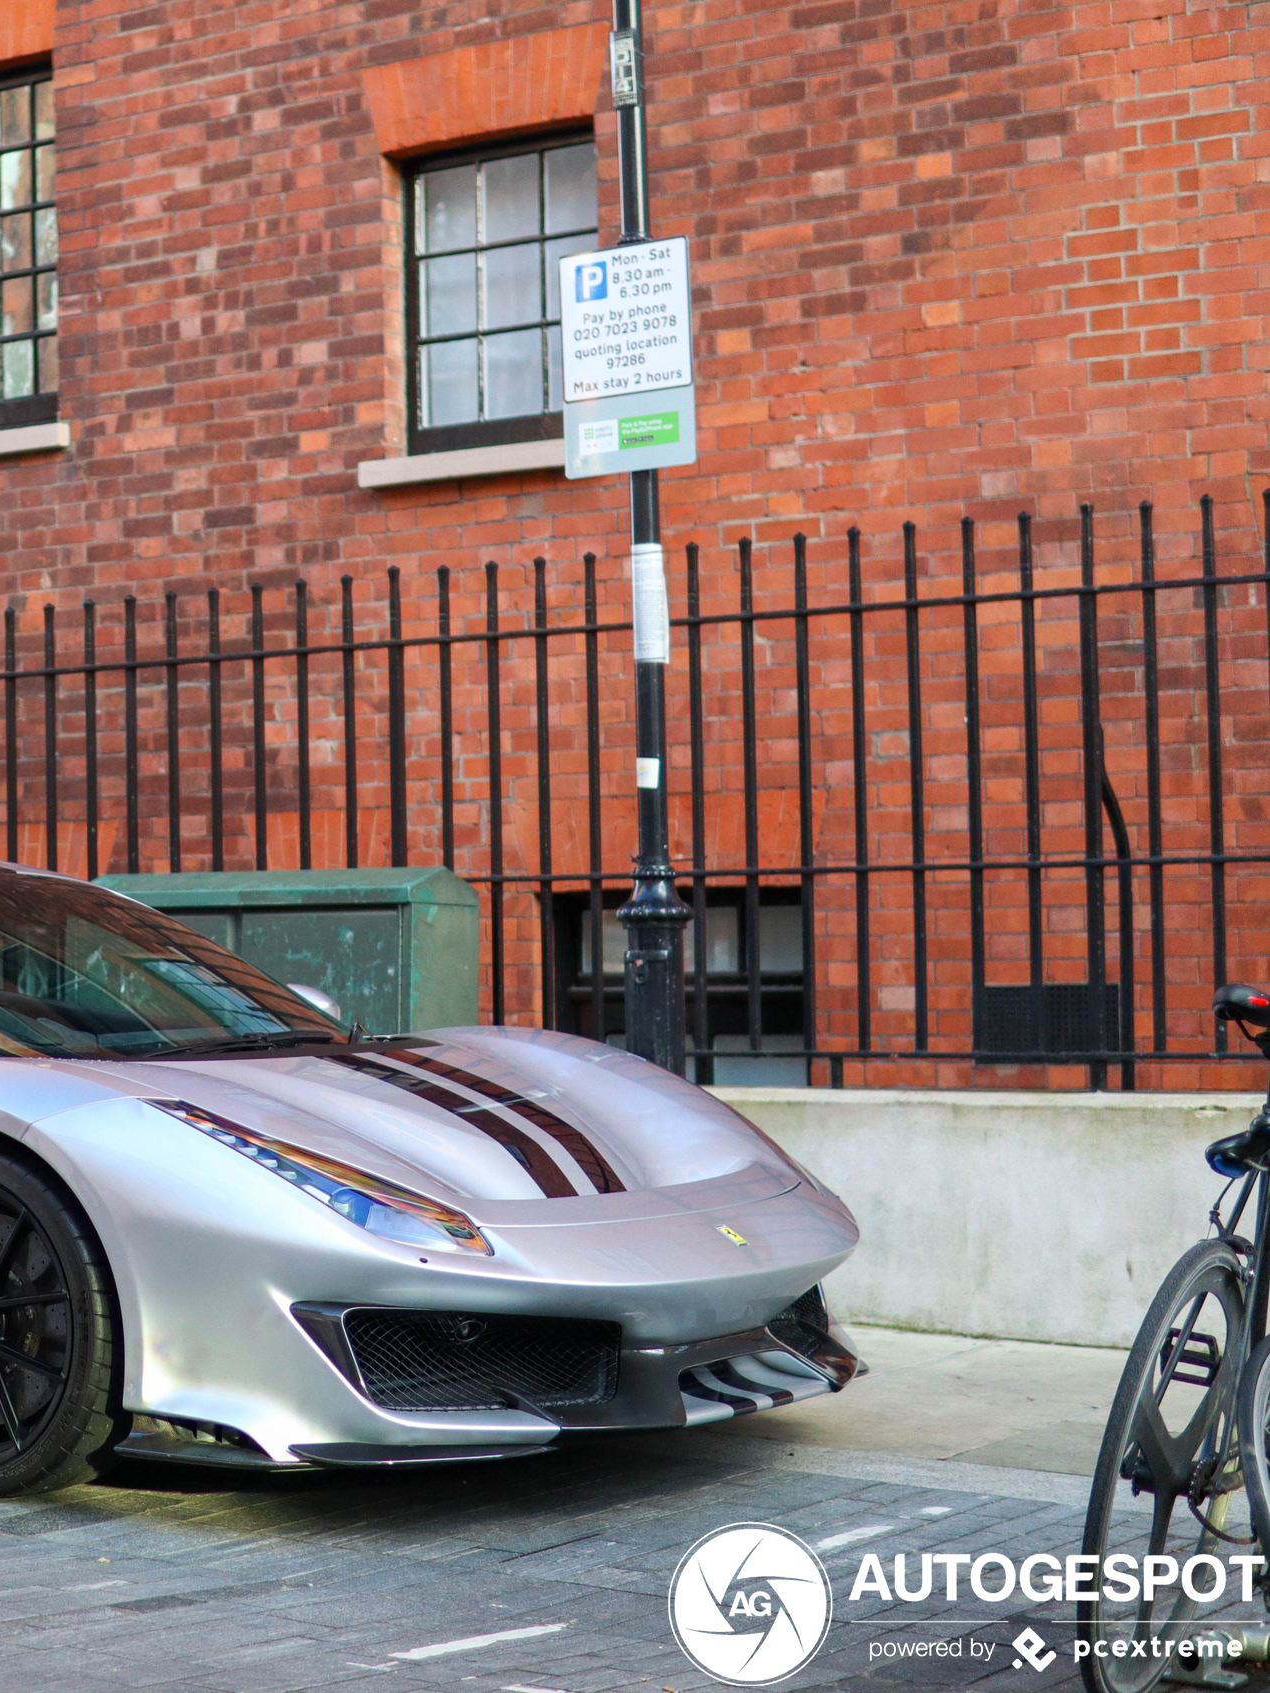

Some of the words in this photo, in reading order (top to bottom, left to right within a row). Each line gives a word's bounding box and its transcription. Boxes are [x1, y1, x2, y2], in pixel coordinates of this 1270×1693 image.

[612, 254, 638, 267] Mon
[649, 247, 671, 261] Sat
[582, 266, 603, 299] P
[613, 268, 643, 284] 8.30
[646, 268, 664, 279] am
[620, 284, 649, 298] 6.30
[653, 282, 672, 295] pm
[584, 312, 605, 325] Pay
[610, 309, 624, 322] by
[629, 303, 667, 318] phone
[574, 327, 600, 341] 020
[605, 320, 637, 337] 7023
[643, 314, 677, 331] 9078
[575, 341, 622, 360] quoting
[626, 333, 677, 351] location
[607, 353, 646, 369] 97286
[574, 381, 599, 394] Max
[604, 376, 630, 390] stay
[634, 373, 642, 385] 2
[647, 368, 683, 383] hours
